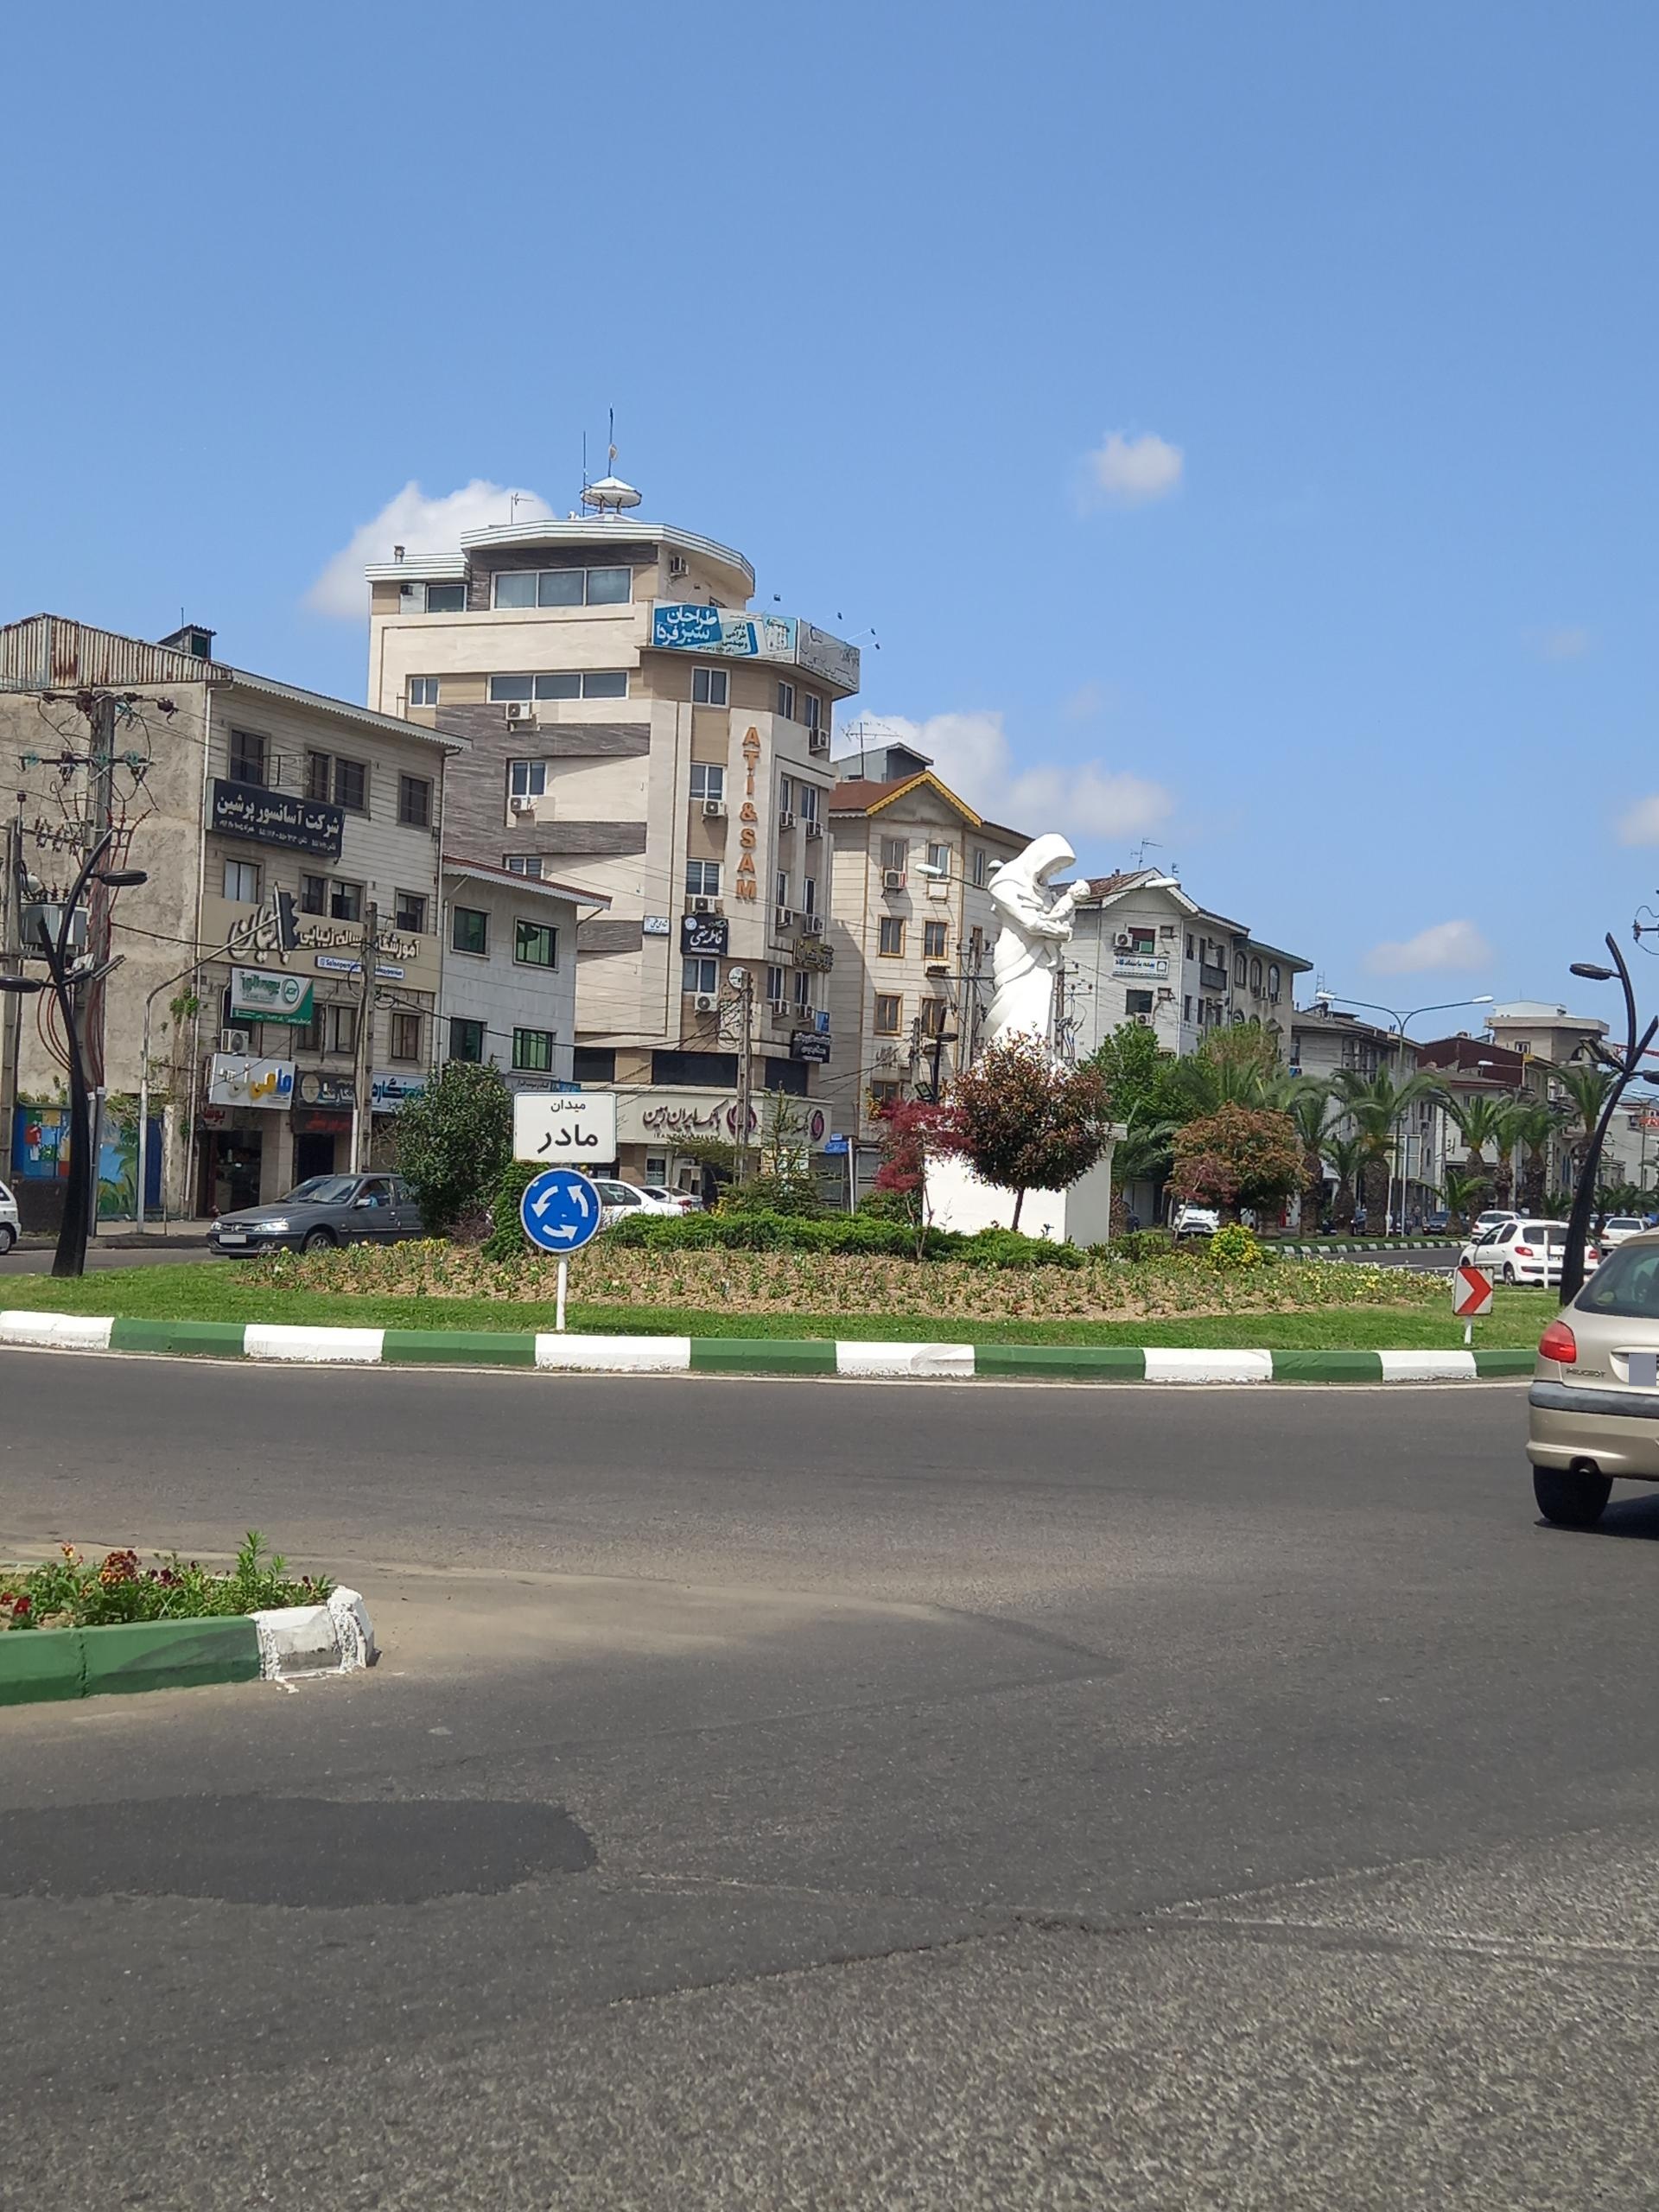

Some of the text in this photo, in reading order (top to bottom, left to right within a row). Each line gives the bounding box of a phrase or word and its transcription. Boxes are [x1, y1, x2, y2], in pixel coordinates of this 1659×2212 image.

[666, 607, 717, 631] طراحان
[657, 623, 710, 645] سبز فردا
[726, 631, 747, 640] طراحی
[217, 794, 255, 822] پرشین
[256, 804, 305, 825] آسانسور
[305, 814, 340, 838] شرکت
[300, 925, 334, 947] زیبایی
[375, 931, 421, 959] آموزشگا
[550, 1099, 586, 1113] میدان
[643, 1105, 668, 1128] زمین
[667, 1107, 697, 1128] ایران
[537, 1124, 599, 1154] مادر
